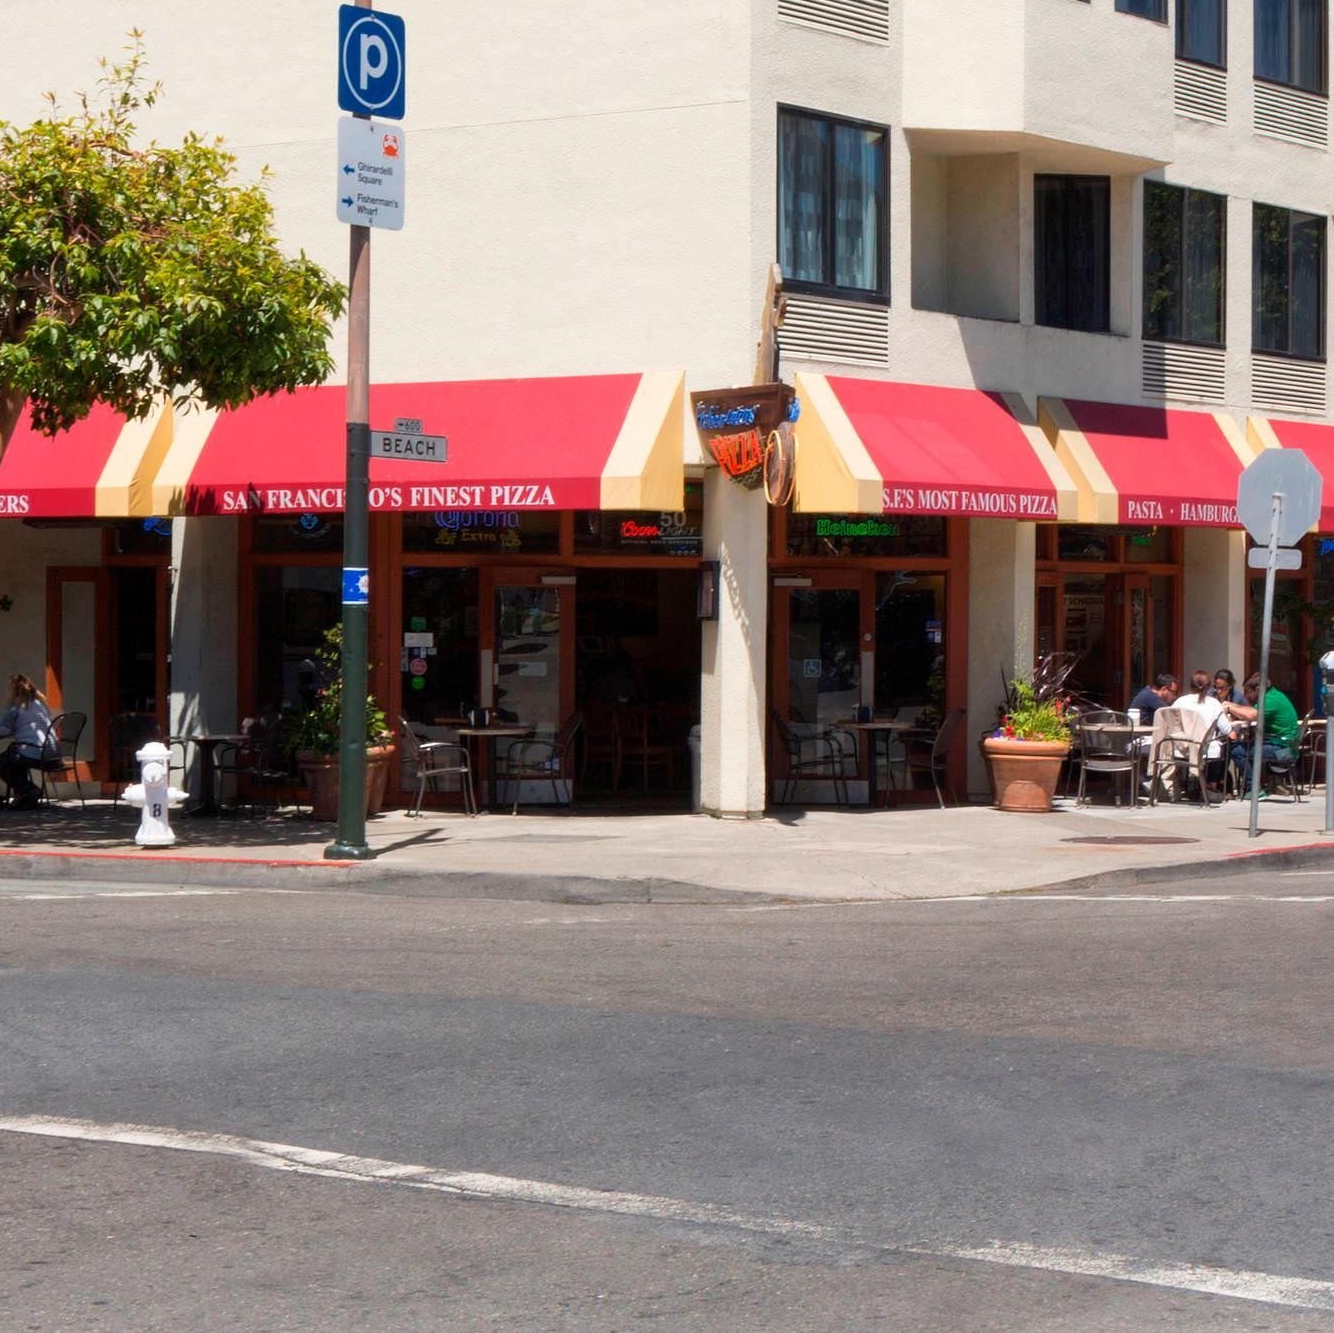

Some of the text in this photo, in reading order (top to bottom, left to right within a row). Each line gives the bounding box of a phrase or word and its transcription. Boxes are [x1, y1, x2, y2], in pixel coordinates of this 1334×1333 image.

[357, 162, 393, 176] Ghirardelli
[357, 173, 383, 186] Square
[357, 194, 399, 208] Fisherman's
[357, 206, 378, 216] Wharf
[382, 437, 436, 456] BEACH
[223, 485, 555, 510] SAN FRANCIO'S FINEST PIZZA
[918, 490, 959, 510] MOST
[963, 491, 1017, 514] FAMOUS
[1019, 496, 1058, 516] PIZZA
[1127, 500, 1163, 519] PASTA
[434, 510, 521, 531] Corona
[817, 518, 899, 536] Heineken
[462, 529, 497, 542] Extra
[153, 803, 162, 818] 8
